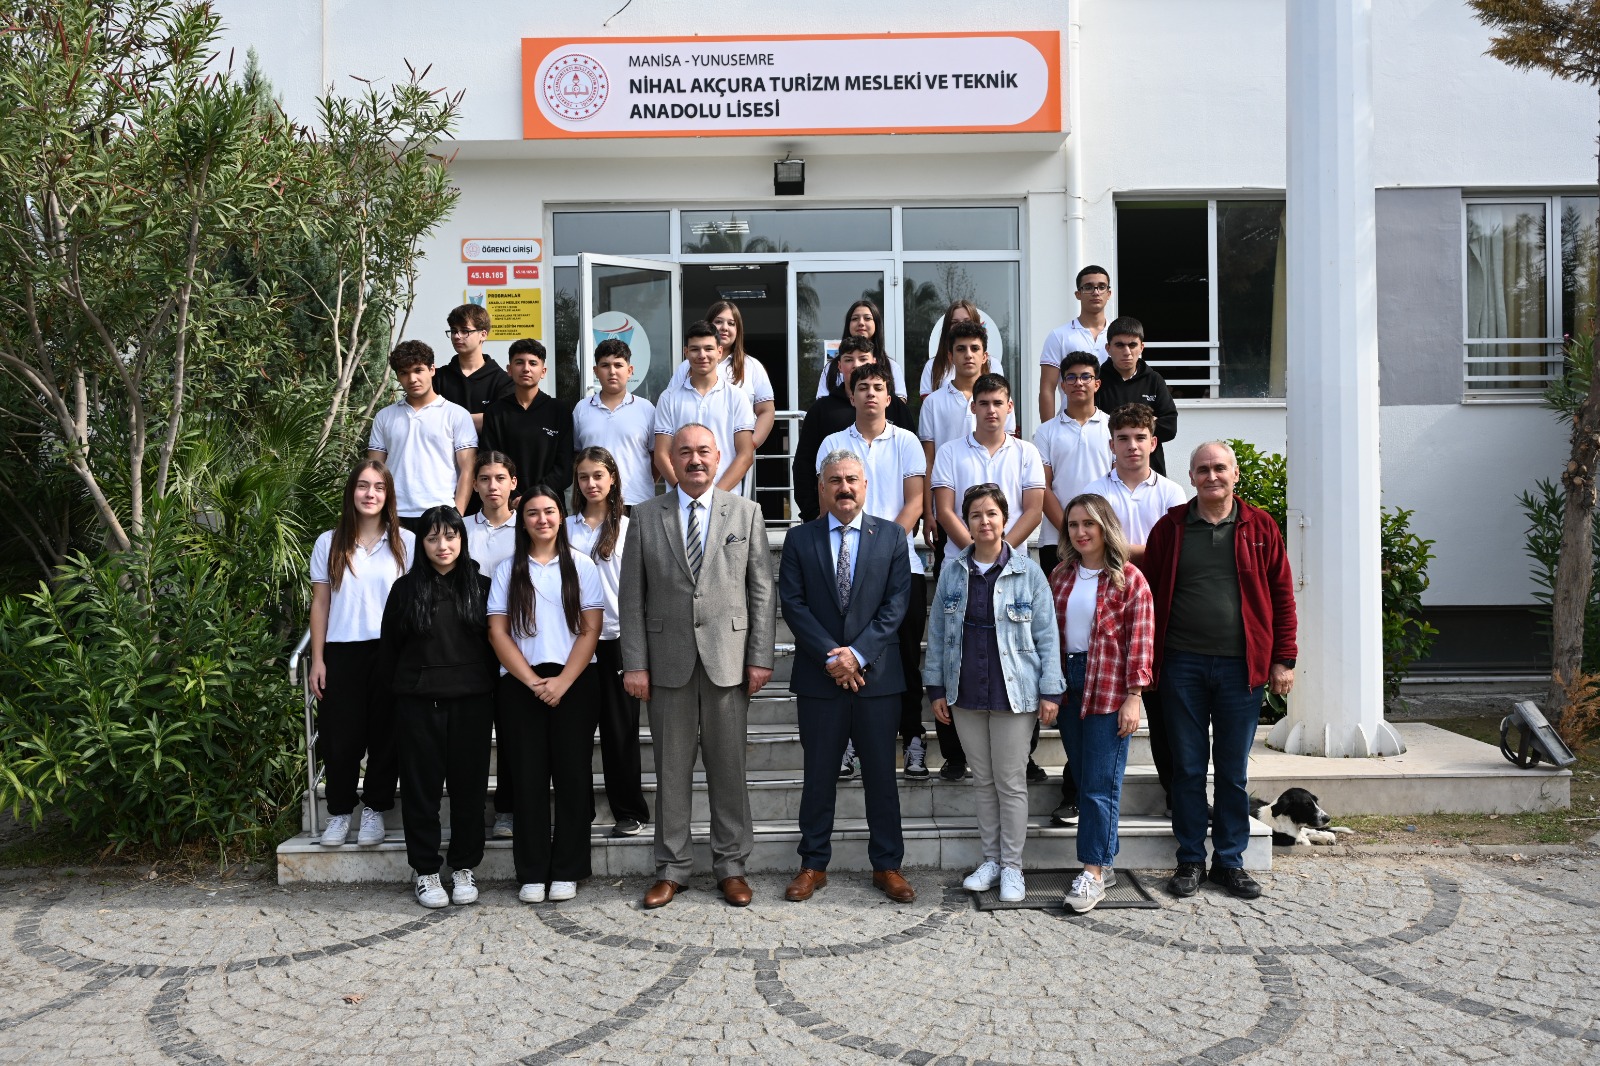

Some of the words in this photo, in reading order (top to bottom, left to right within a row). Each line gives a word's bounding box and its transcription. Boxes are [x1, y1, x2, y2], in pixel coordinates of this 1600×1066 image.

[628, 53, 682, 68] MANİSA
[691, 53, 775, 67] YUNUSEMRE
[629, 75, 687, 94] NİHAL
[690, 77, 767, 98] AKÇURA
[769, 73, 840, 93] TURİZM
[844, 72, 922, 91] MESLEKİ
[924, 74, 949, 90] VE
[951, 69, 1019, 89] TEKNİK
[629, 103, 721, 119] ANADOLU
[726, 99, 780, 118] LİSESİ
[481, 244, 511, 253] ÖĞRENCİ
[512, 244, 533, 254] GİRİŞİ
